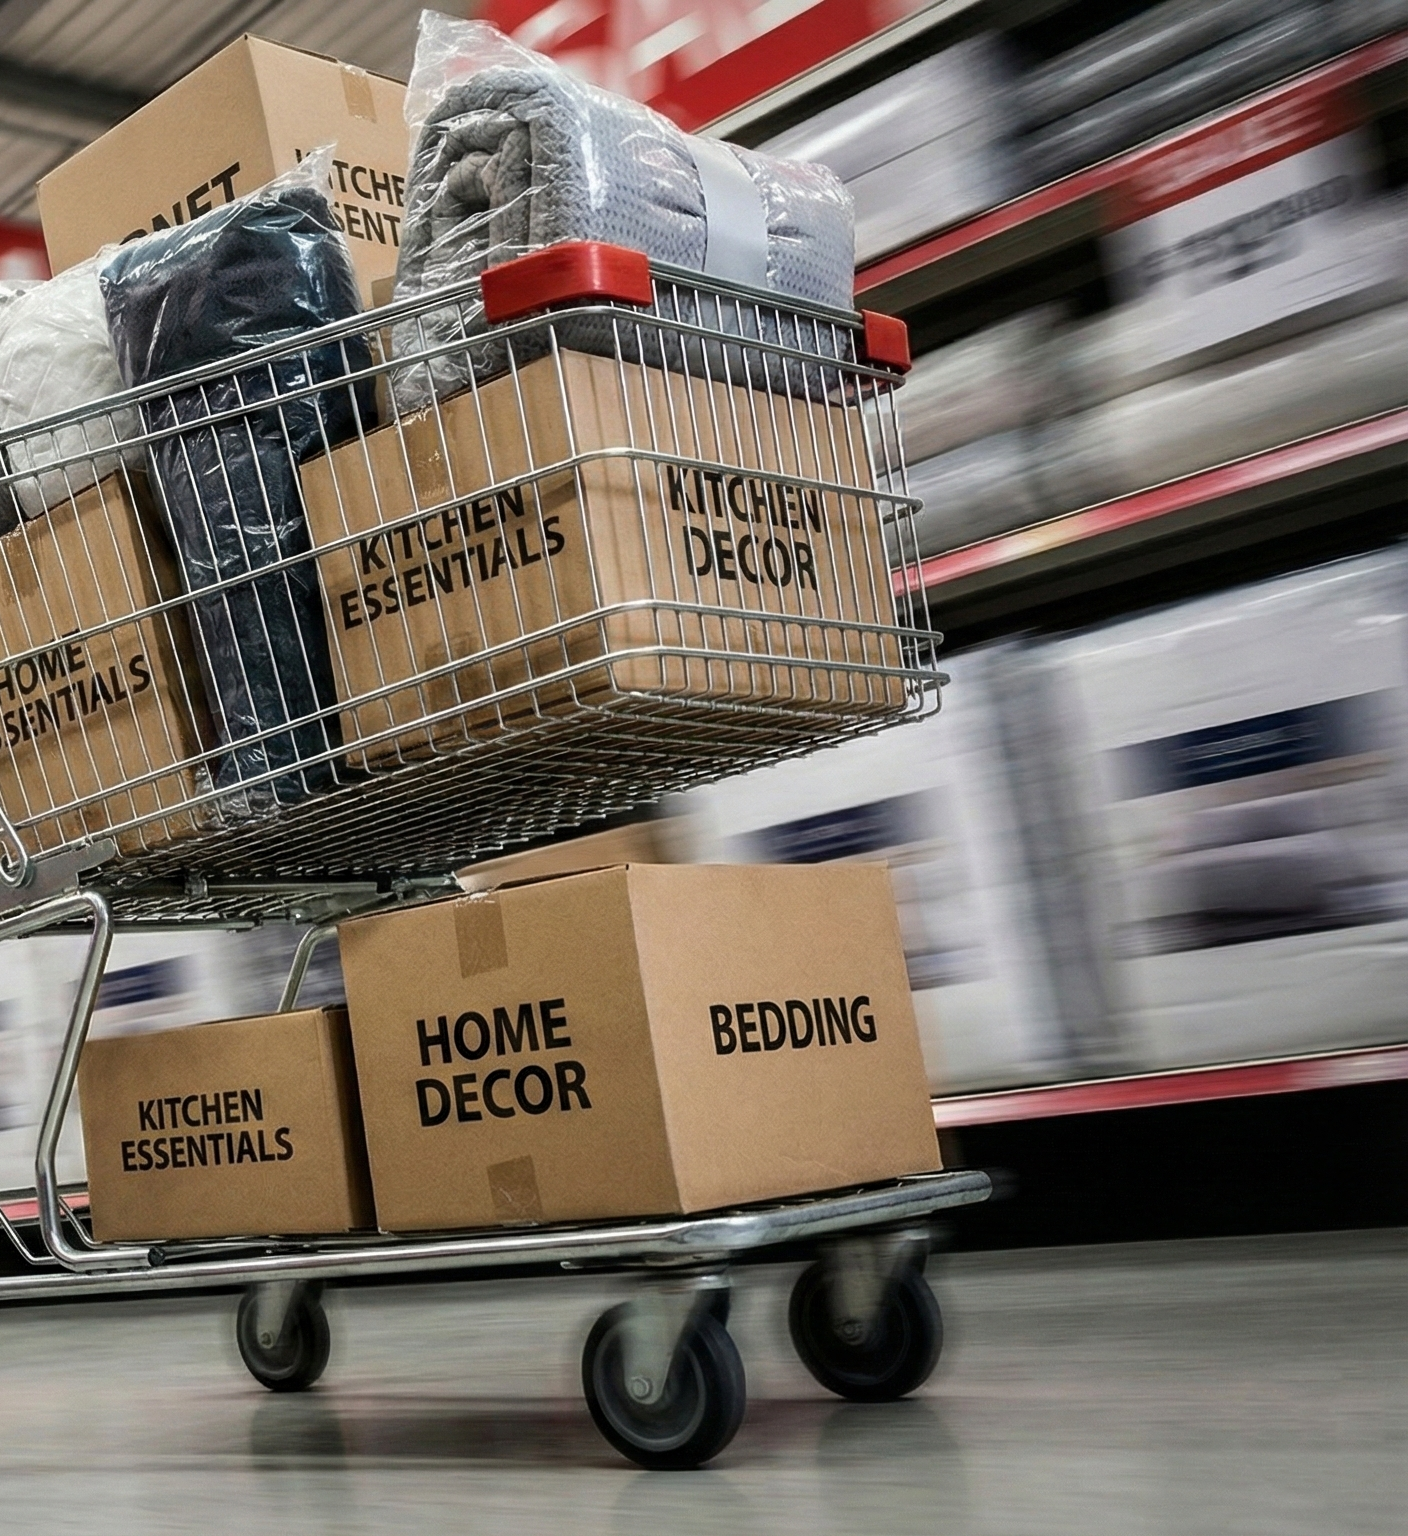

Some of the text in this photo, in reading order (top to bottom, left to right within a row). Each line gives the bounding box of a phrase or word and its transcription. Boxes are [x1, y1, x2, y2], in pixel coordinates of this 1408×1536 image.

[119, 161, 240, 246] NET
[359, 485, 525, 575] KITCHEN
[667, 465, 821, 533] KITCHEN
[340, 515, 565, 630] ESSENTIALS
[683, 525, 818, 591] DECOR
[416, 999, 572, 1067] HOME
[709, 995, 877, 1056] BEDDING
[138, 1088, 263, 1132] KITCHEN
[416, 1060, 592, 1127] DECOR
[121, 1126, 294, 1172] ESSENTIALS
